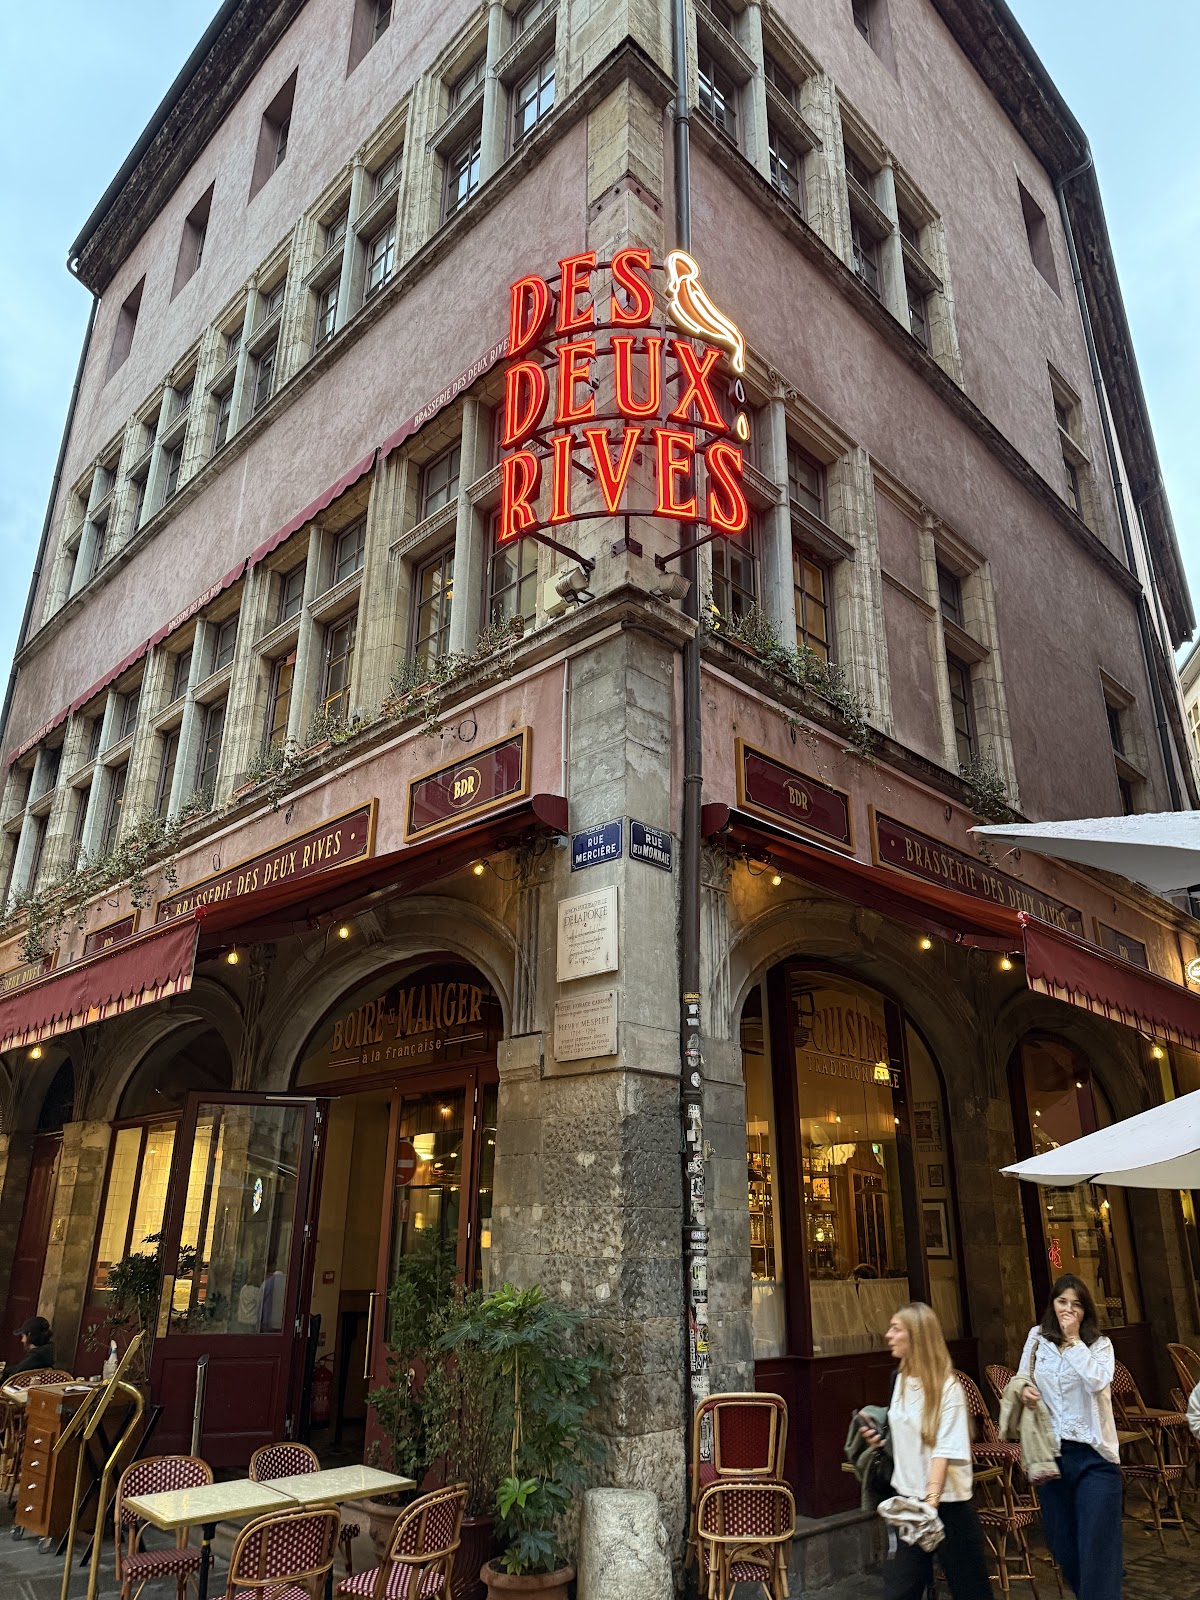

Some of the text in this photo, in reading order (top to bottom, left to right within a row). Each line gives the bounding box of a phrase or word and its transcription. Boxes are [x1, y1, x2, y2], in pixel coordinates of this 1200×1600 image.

[506, 247, 655, 358] DES
[413, 387, 451, 428] BRASSERIE
[452, 374, 468, 395] DES
[467, 355, 488, 382] DEUX
[501, 336, 730, 450] DEUX
[497, 427, 749, 543] RIVES
[453, 775, 475, 800] BDR
[787, 785, 809, 811] BDR
[575, 843, 617, 864] MERCIÈRE
[587, 834, 604, 848] RUE
[642, 844, 671, 866] MONNAIE
[645, 833, 663, 849] RUE
[236, 868, 259, 897] DES
[263, 852, 297, 886] DEUX
[302, 830, 343, 869] RIVES
[904, 836, 978, 891] BRASSERIE
[981, 872, 1005, 906] DES
[1008, 885, 1036, 916] DEUX
[331, 982, 483, 1054] BOIRE & MANGER
[362, 1038, 442, 1064] à la française
[806, 1055, 900, 1089] TRADITIONNELLE
